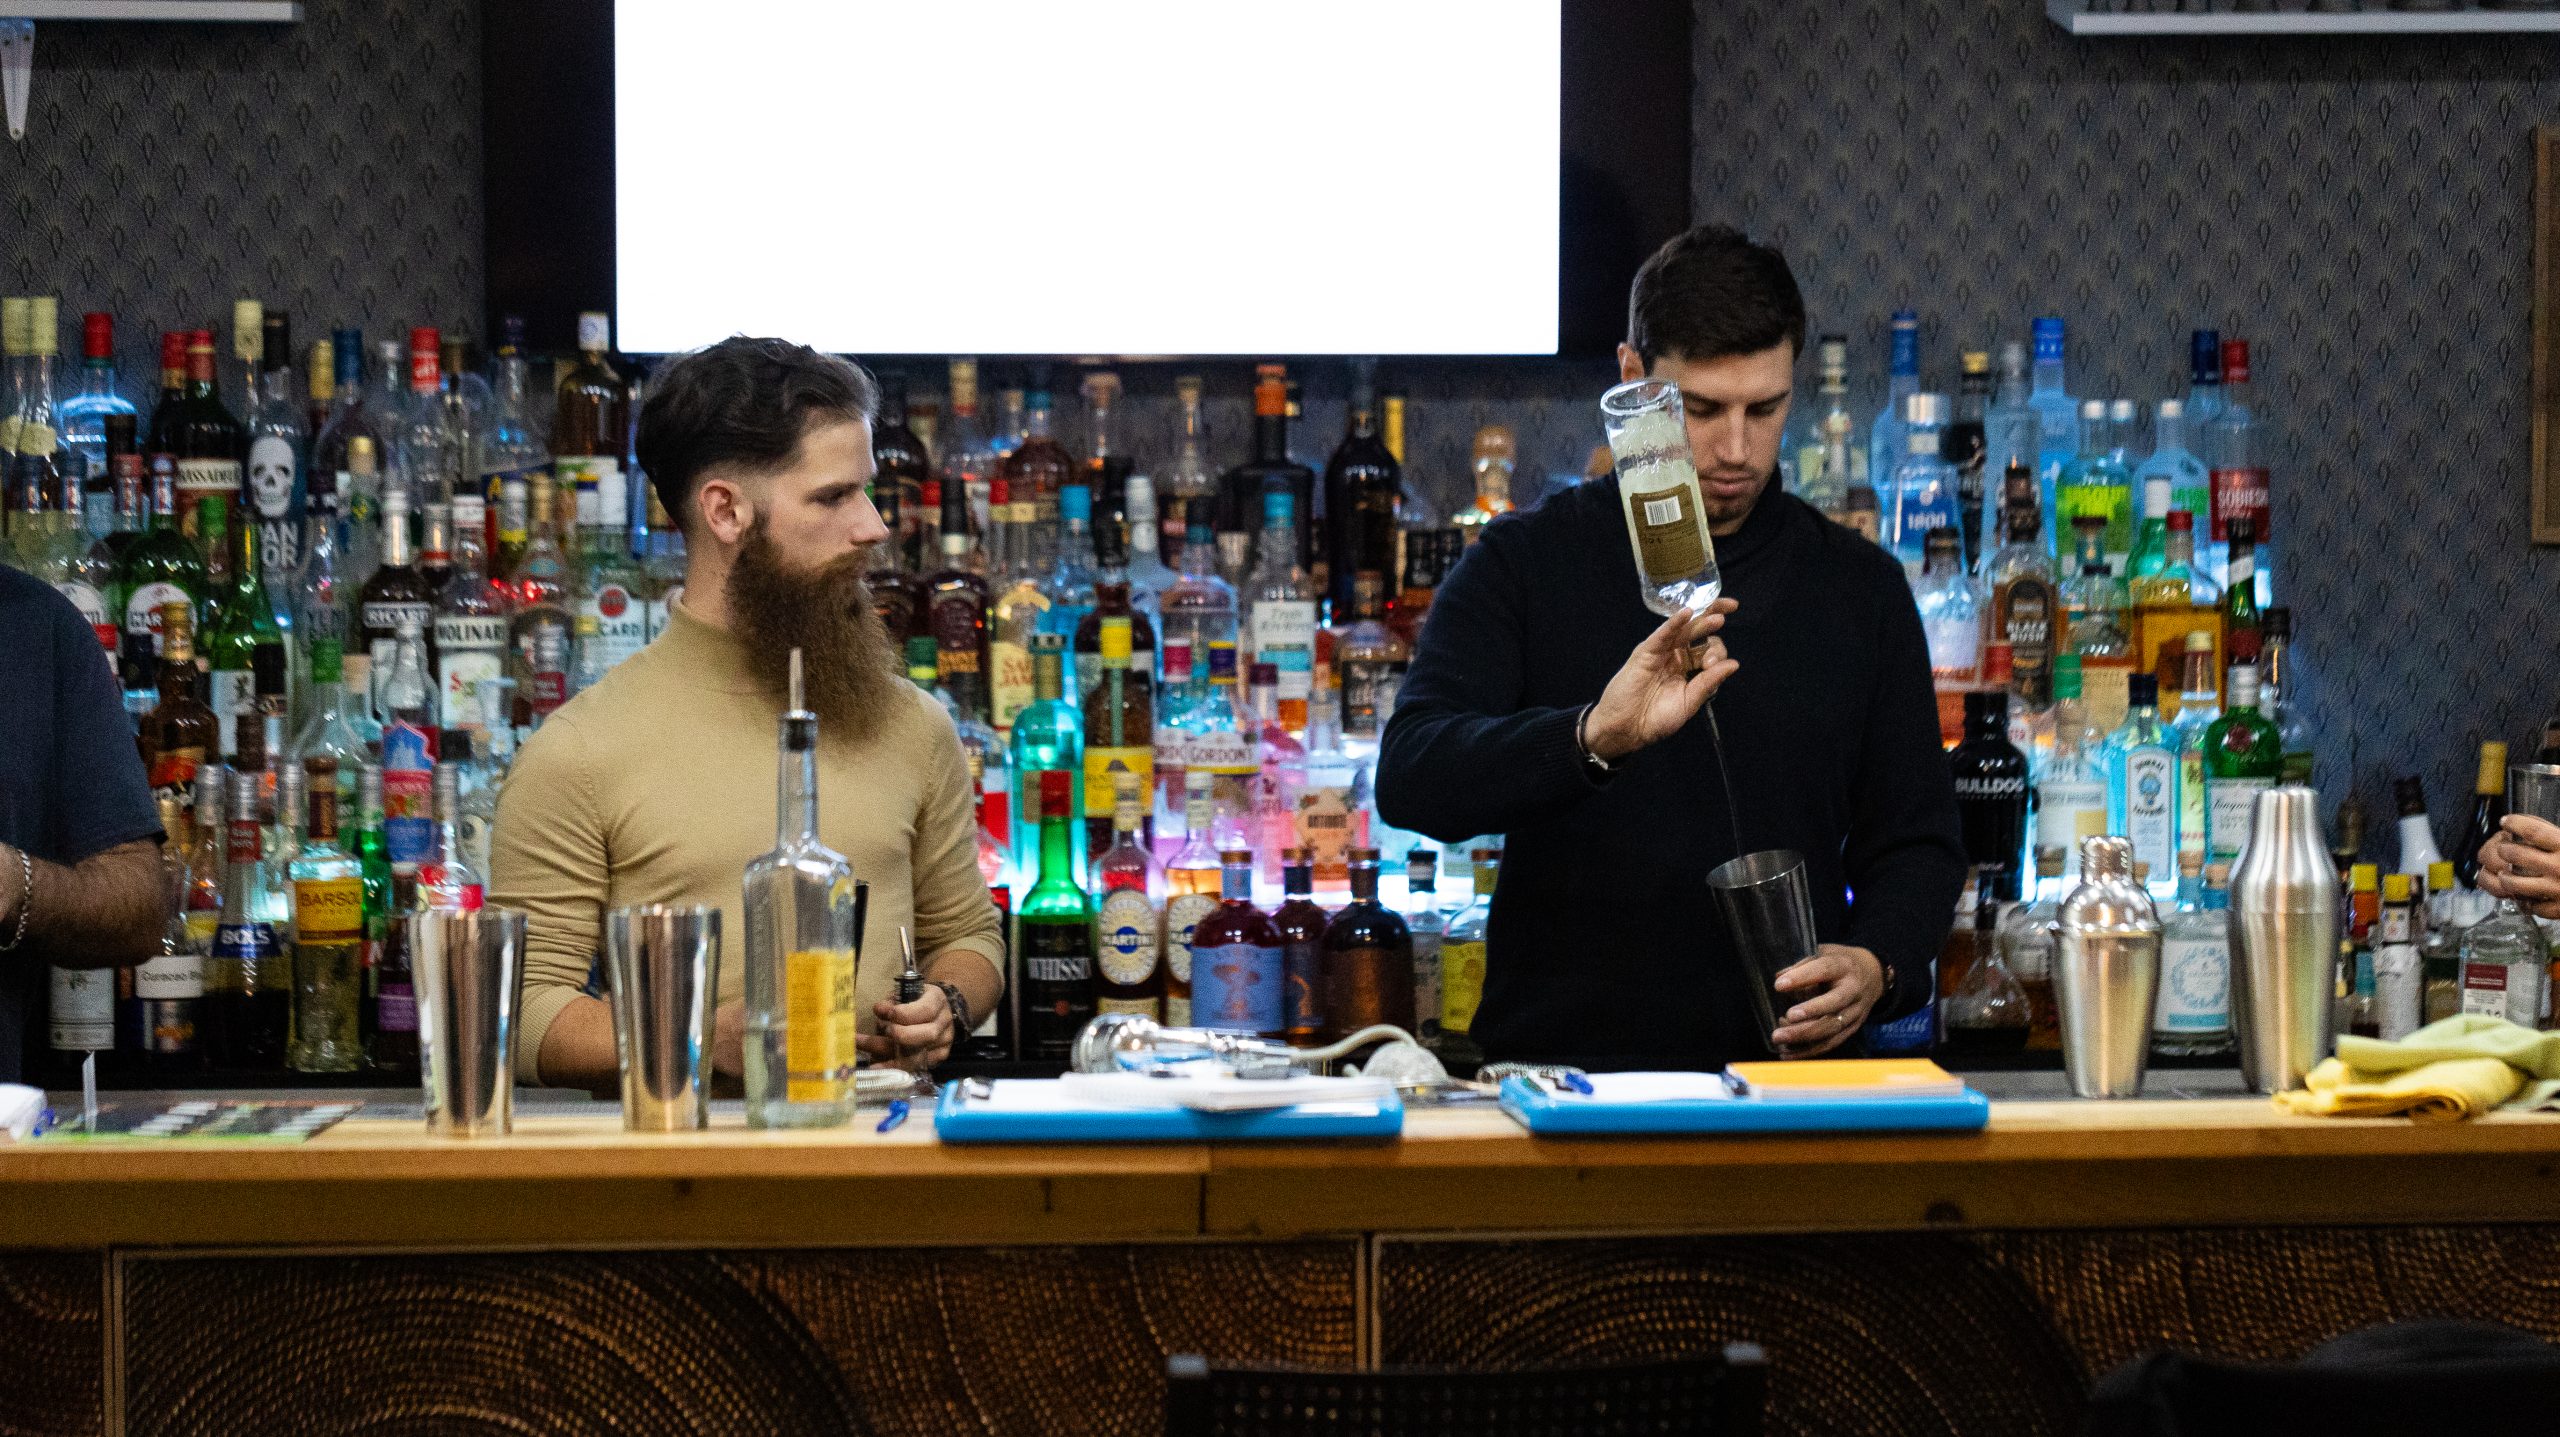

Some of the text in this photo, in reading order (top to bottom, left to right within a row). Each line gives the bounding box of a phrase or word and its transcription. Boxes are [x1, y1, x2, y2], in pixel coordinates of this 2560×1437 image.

[258, 520, 298, 545] AN
[2006, 619, 2048, 634] BLACK
[1955, 777, 2025, 793] BULLDOG
[220, 929, 271, 946] BOLS
